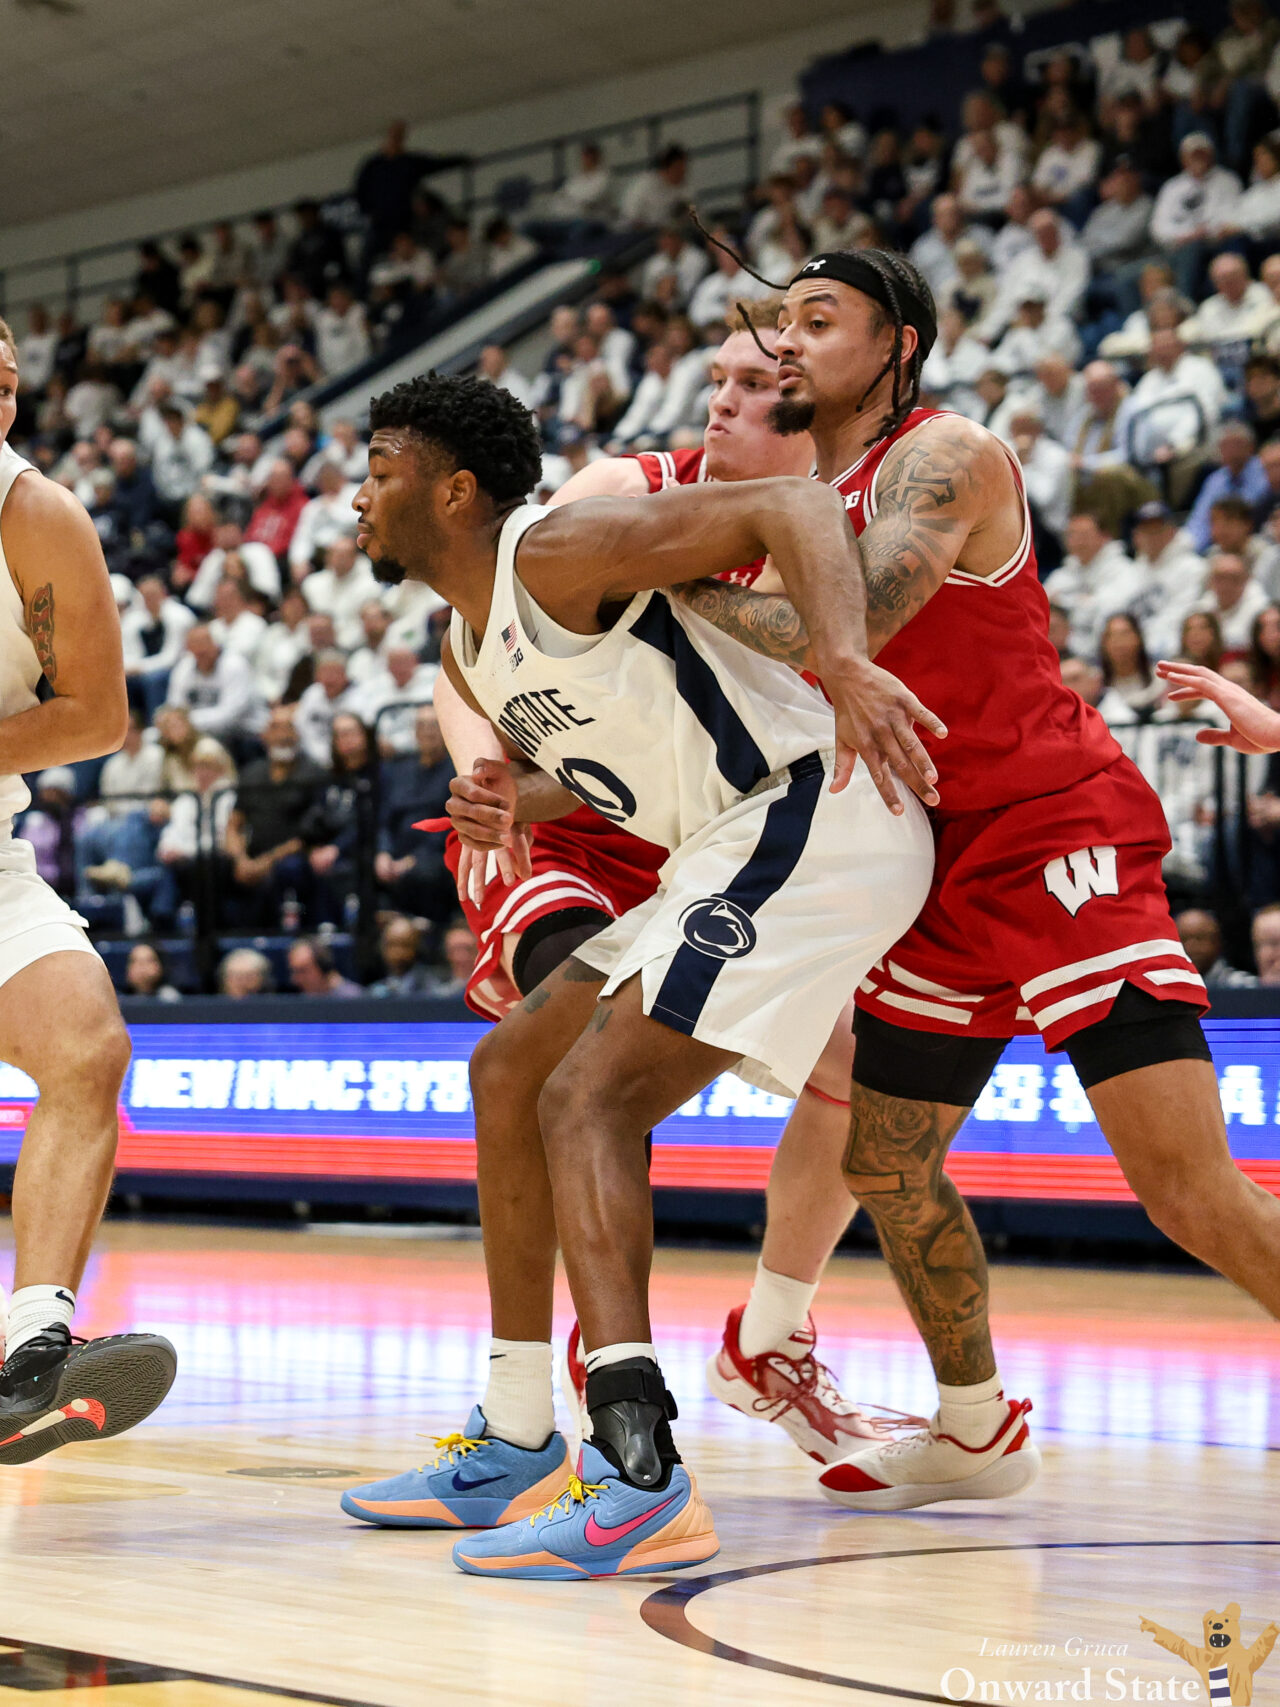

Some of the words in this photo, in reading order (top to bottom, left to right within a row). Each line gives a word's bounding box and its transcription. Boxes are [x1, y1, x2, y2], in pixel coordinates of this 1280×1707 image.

[1043, 845, 1120, 919] W
[130, 1058, 236, 1110] NEW
[233, 1059, 367, 1112] HVAC
